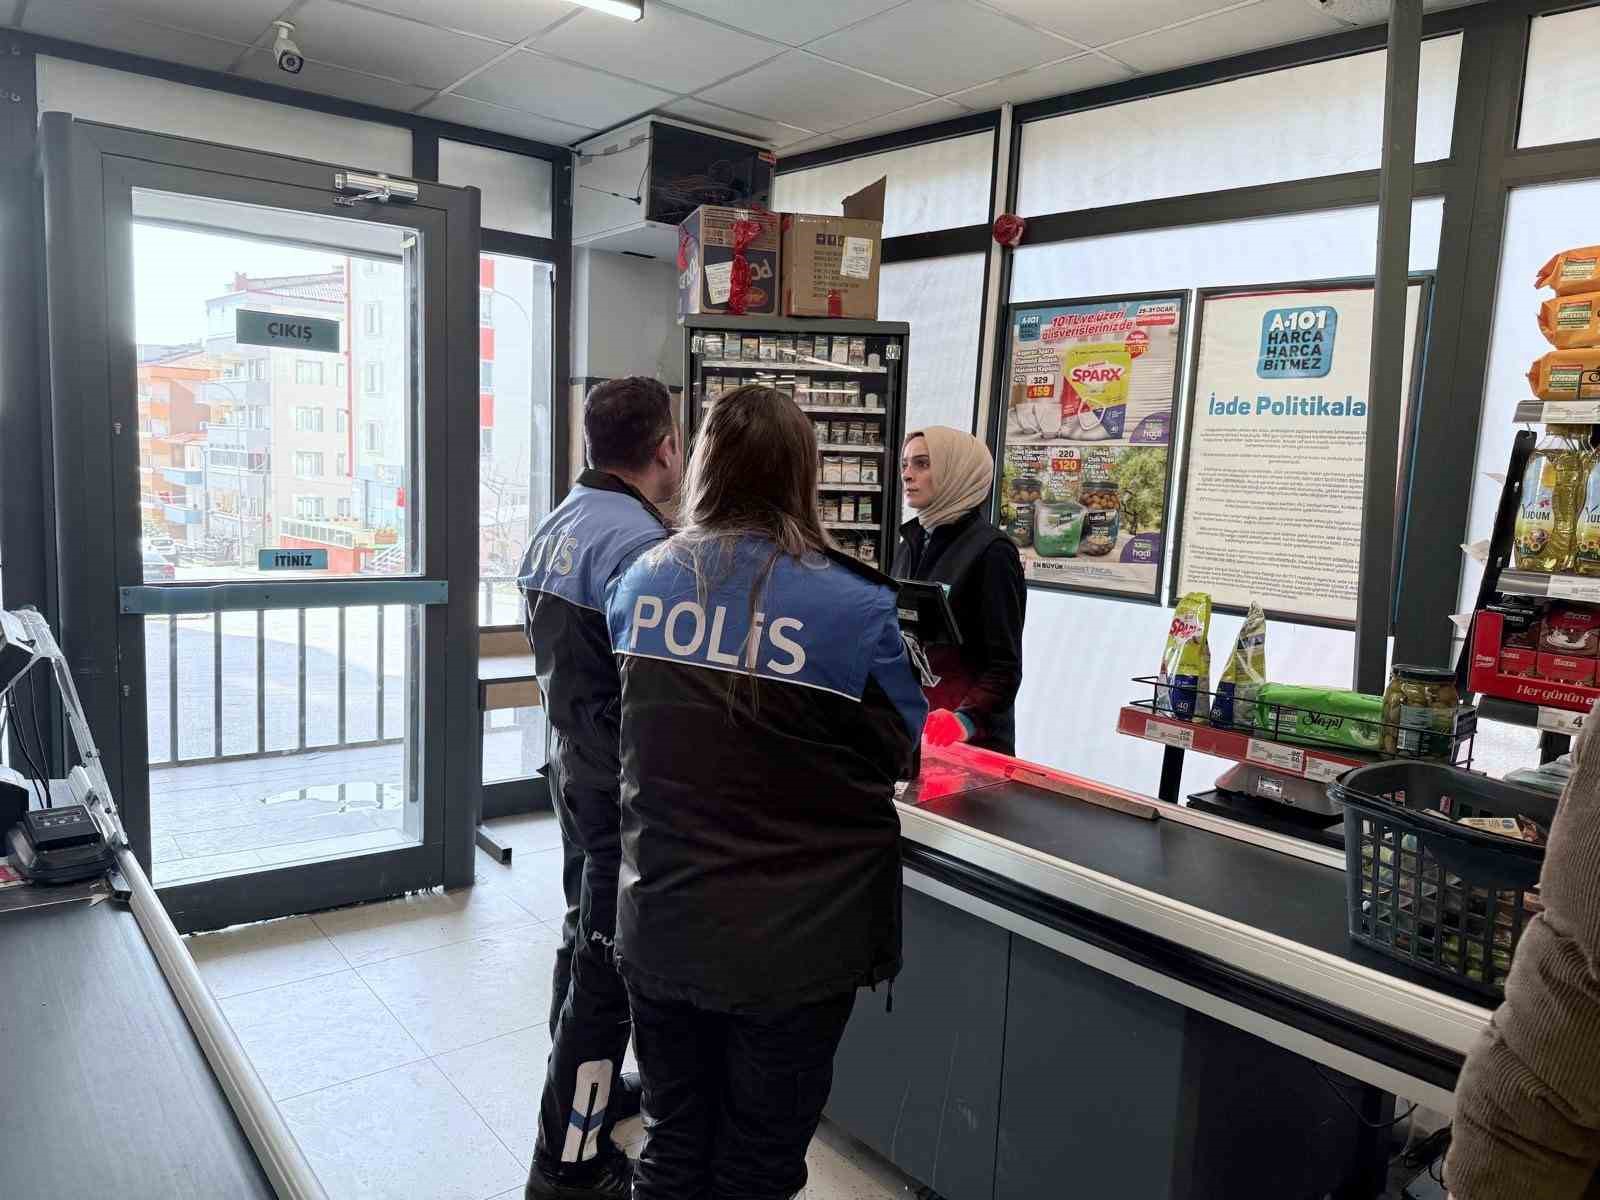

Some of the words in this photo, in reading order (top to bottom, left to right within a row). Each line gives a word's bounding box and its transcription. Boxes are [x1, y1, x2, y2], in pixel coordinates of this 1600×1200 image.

[267, 321, 313, 342] ÇIKIŞ
[1268, 330, 1324, 345] HARCA
[1266, 344, 1322, 358] HARCA
[1071, 367, 1122, 382] SPARX
[1208, 392, 1251, 416] İade
[1256, 395, 1367, 417] Politikala
[1058, 450, 1074, 458] 220
[1516, 684, 1541, 697] Her
[1542, 688, 1584, 705] günün
